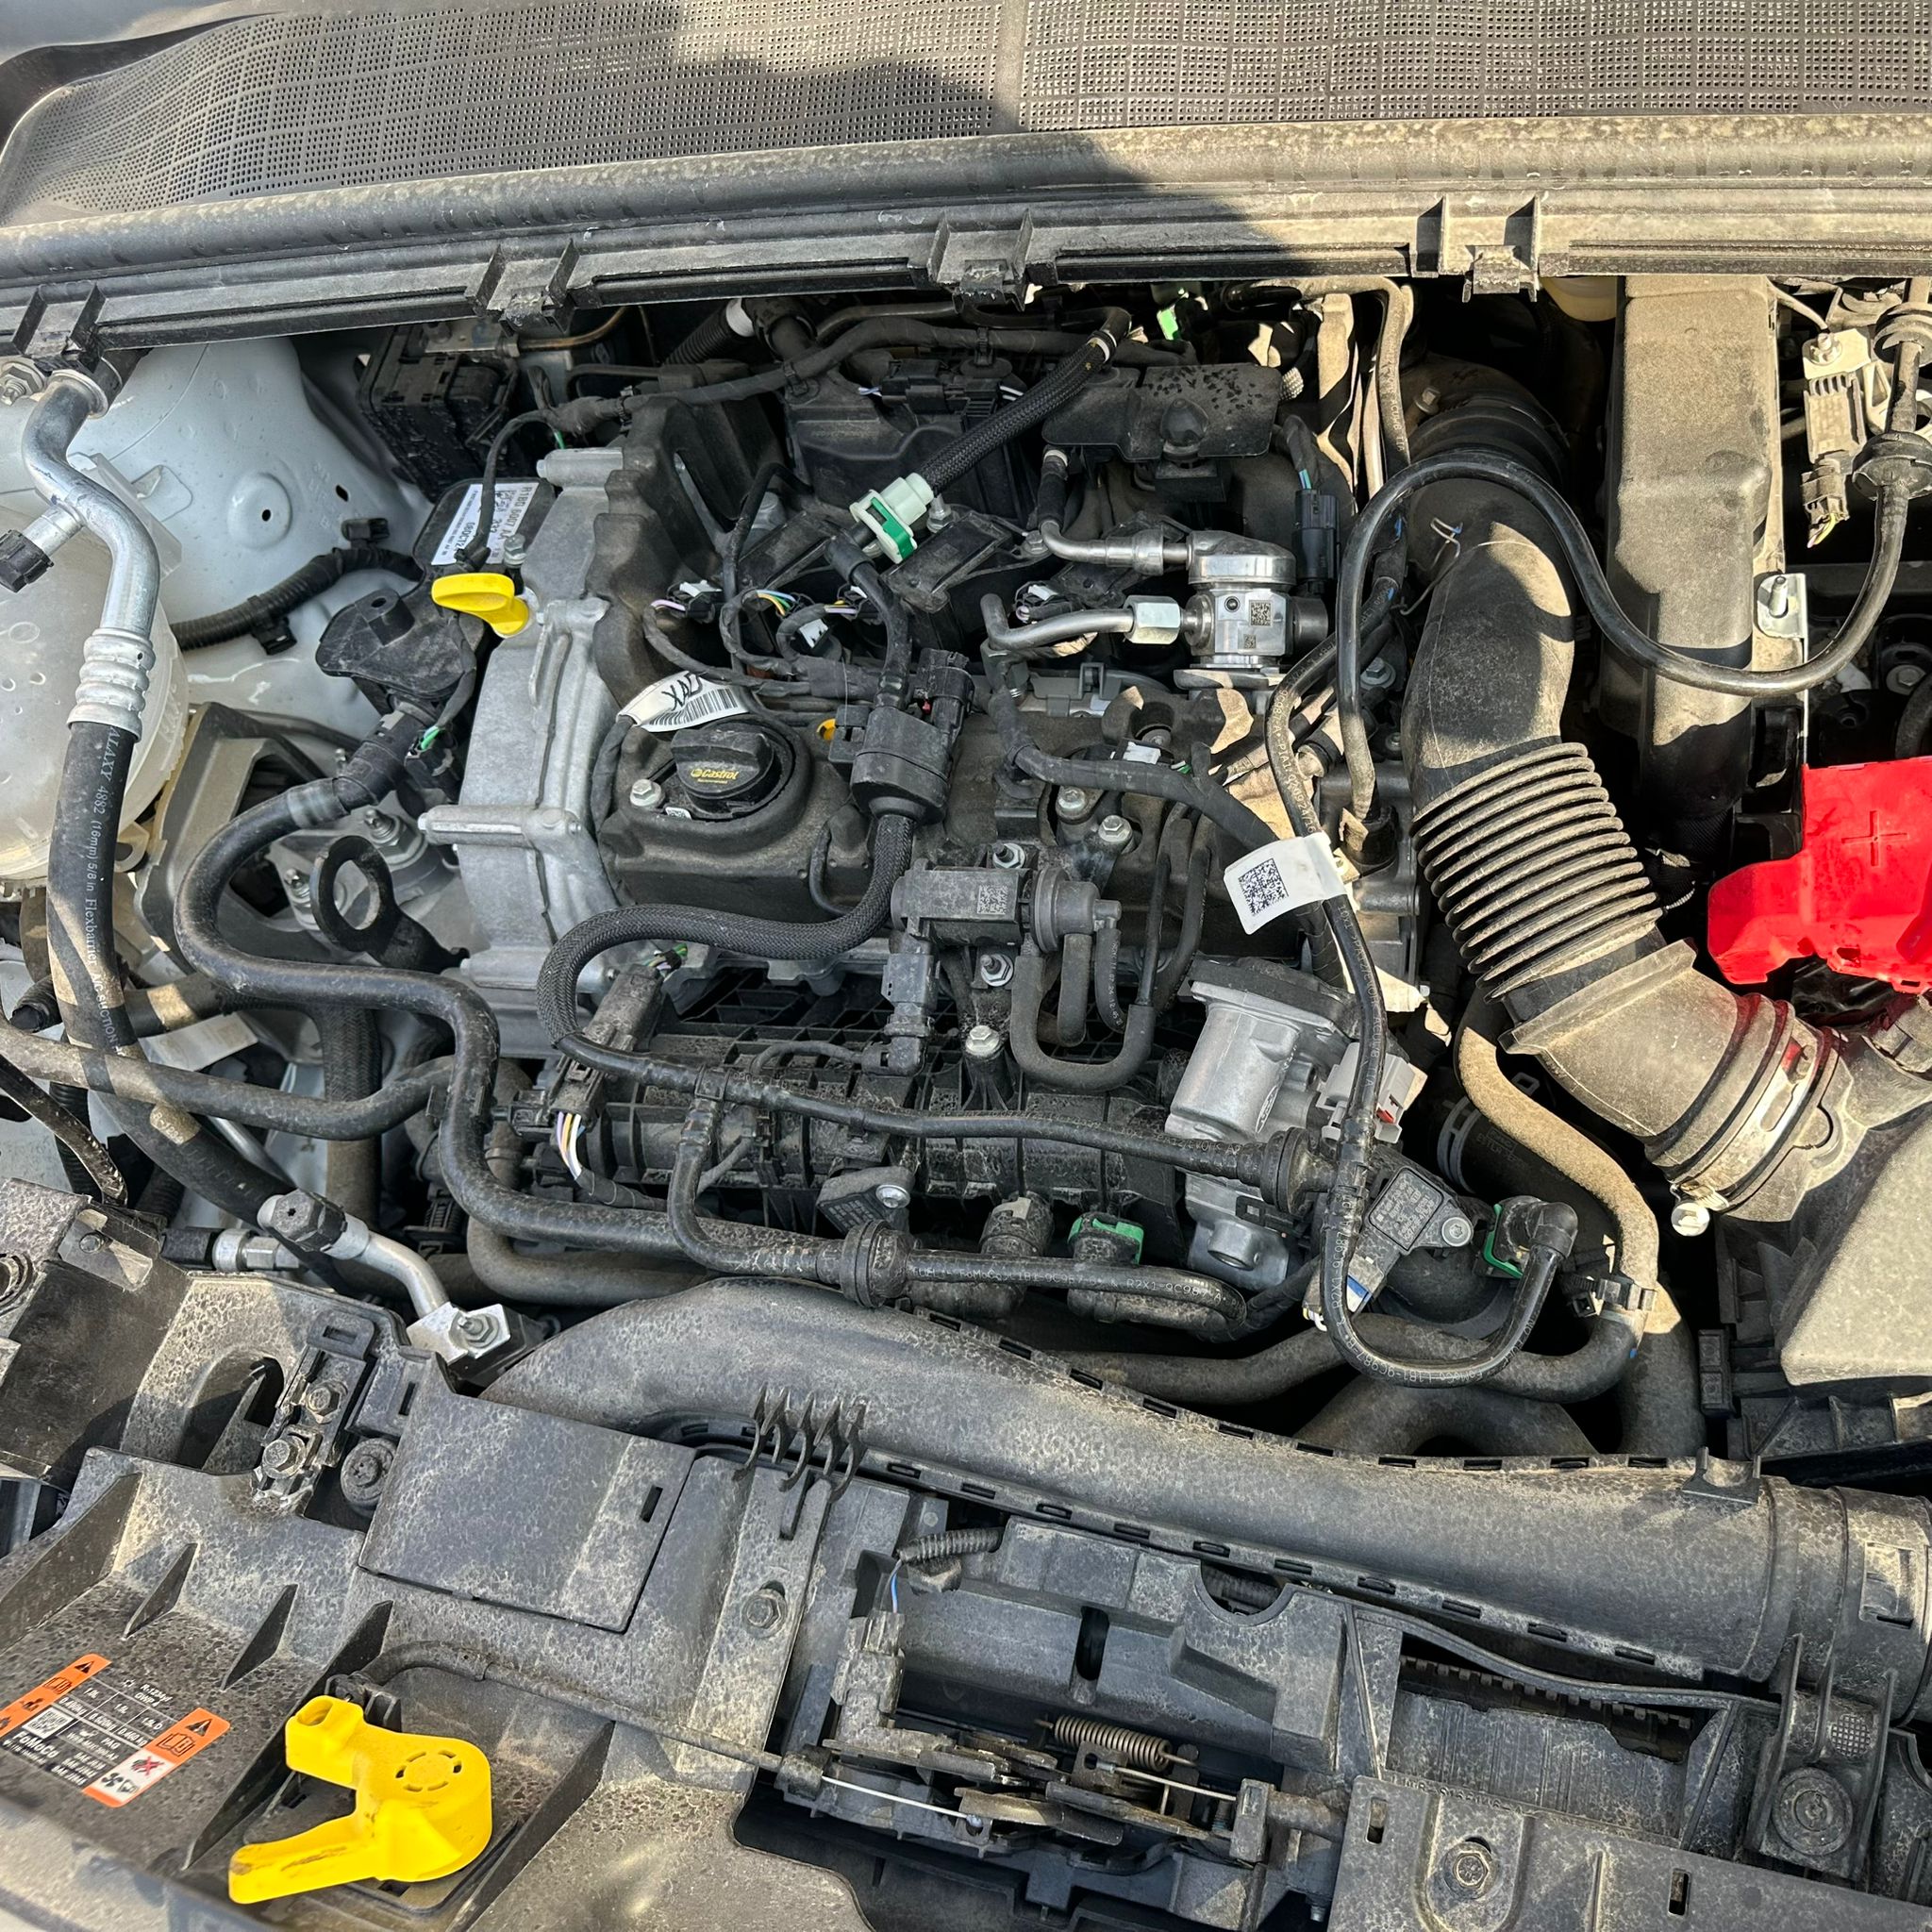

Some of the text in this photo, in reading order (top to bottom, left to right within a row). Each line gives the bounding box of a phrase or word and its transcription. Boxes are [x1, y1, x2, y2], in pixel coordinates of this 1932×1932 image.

[100, 725, 120, 782] ALAXY
[701, 768, 740, 781] Castrol
[93, 785, 108, 814] 4882
[86, 820, 103, 859] (16mm)
[87, 862, 98, 879] 5/8
[84, 898, 98, 966] Flexbarrier
[12, 1730, 60, 1758] FoMoCo
